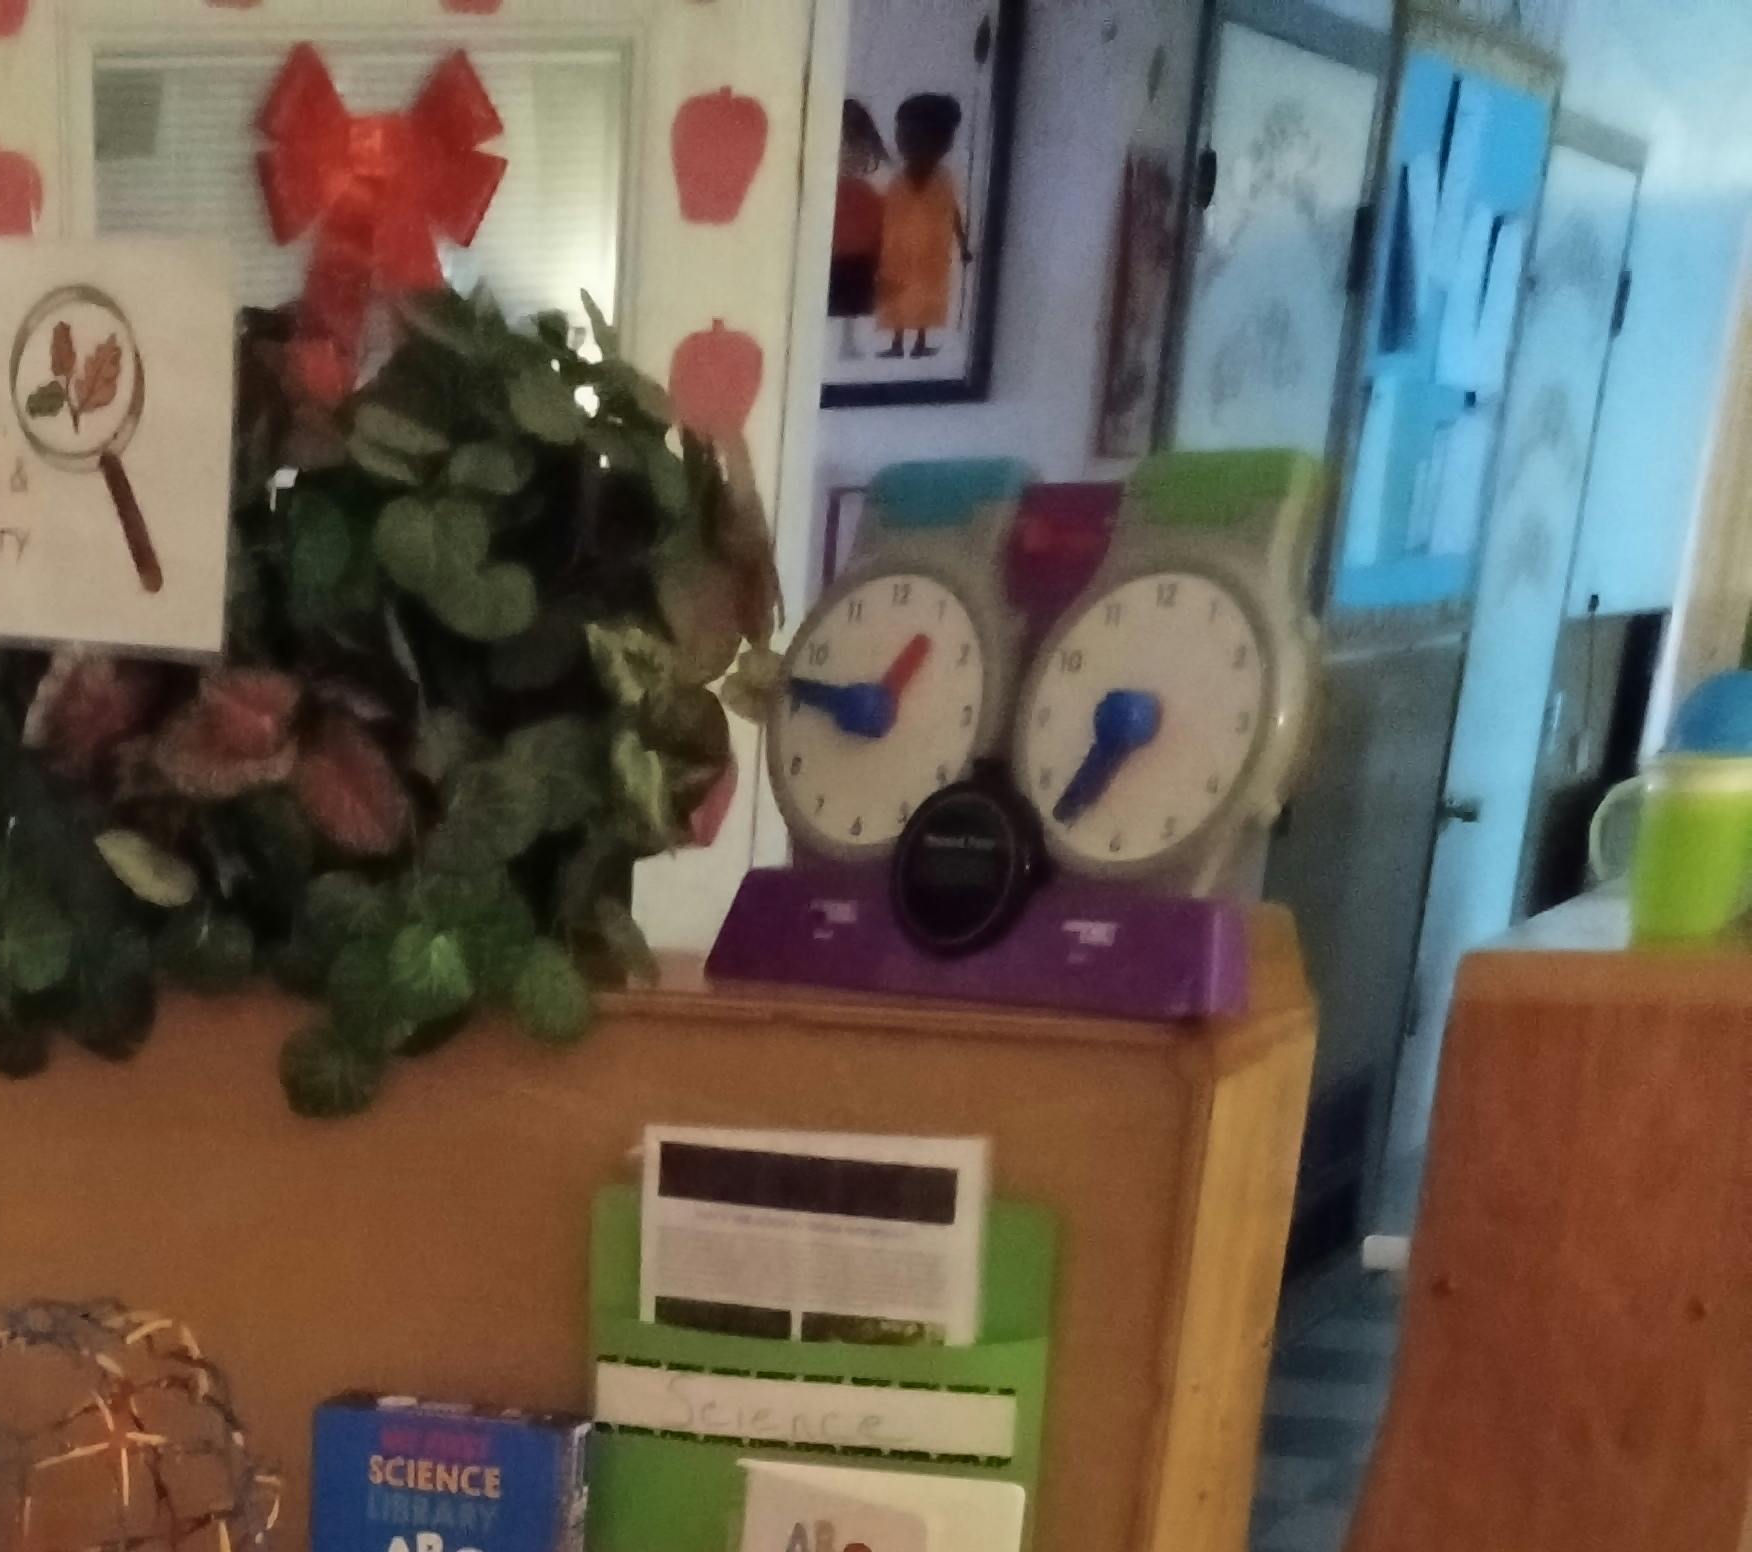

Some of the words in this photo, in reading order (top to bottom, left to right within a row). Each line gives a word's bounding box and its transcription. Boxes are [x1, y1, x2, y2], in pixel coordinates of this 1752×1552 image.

[9, 459, 29, 493] &
[891, 583, 913, 606] 12
[1156, 583, 1179, 607] 12
[847, 600, 864, 622] 11
[1104, 603, 1122, 626] 11
[808, 642, 830, 666] 10
[1060, 649, 1083, 672] 10
[666, 1373, 912, 1443] Science
[368, 1454, 503, 1499] SCIENCE
